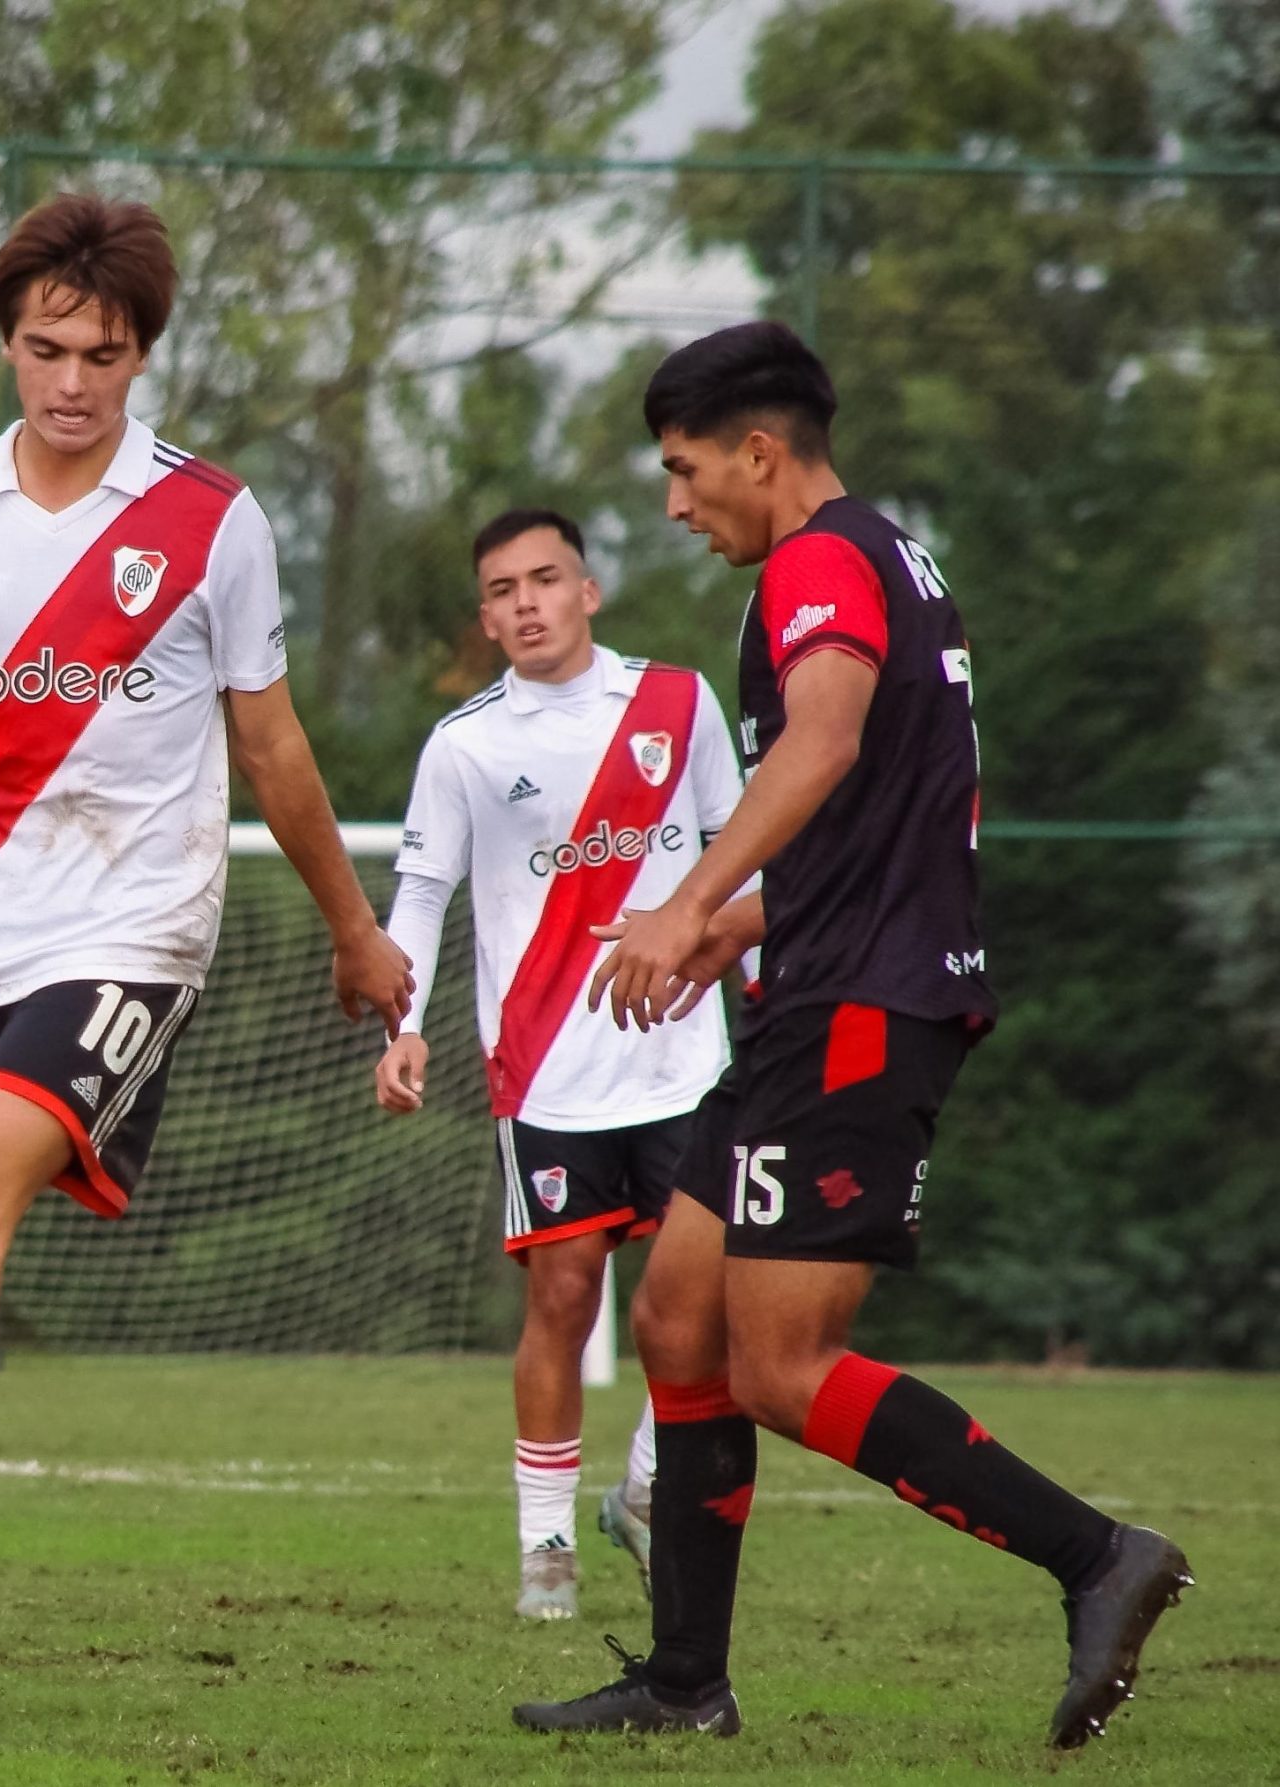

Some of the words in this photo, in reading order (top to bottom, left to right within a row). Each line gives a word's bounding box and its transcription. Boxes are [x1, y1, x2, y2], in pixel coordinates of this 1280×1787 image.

[529, 820, 685, 877] codere
[78, 982, 152, 1075] 10
[732, 1145, 787, 1225] 15
